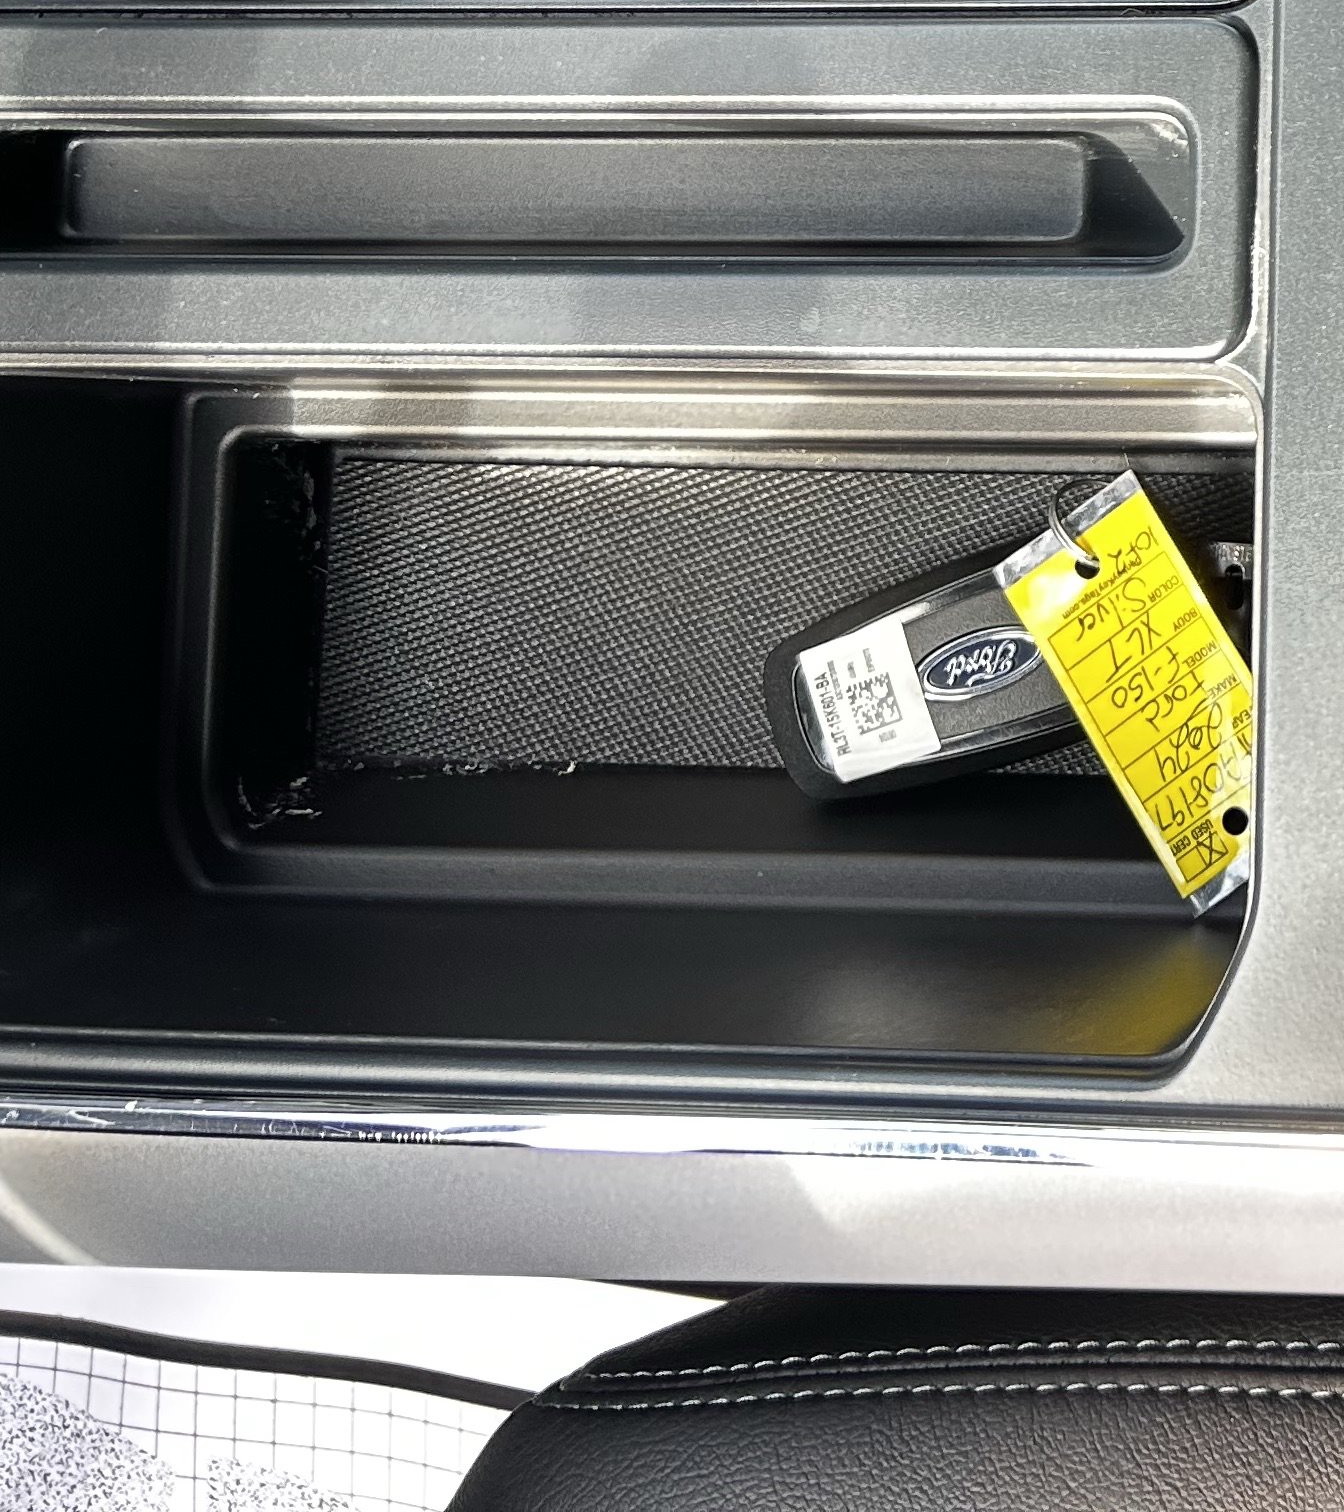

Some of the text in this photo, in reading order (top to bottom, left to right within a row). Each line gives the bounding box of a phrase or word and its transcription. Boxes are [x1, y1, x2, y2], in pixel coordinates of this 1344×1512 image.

[1076, 577, 1146, 642] Silver
[1148, 575, 1179, 603] COLOR
[1173, 607, 1199, 633] BODY
[943, 640, 1017, 686] Ford
[1105, 611, 1162, 684] XLT
[1182, 641, 1217, 668] MODEL
[1111, 645, 1180, 709] F-150
[1208, 674, 1237, 698] MAKE
[1141, 671, 1206, 732] Ford
[1233, 706, 1252, 728] EAR
[1154, 701, 1222, 782] 2024
[1170, 818, 1214, 856] USED CERT
